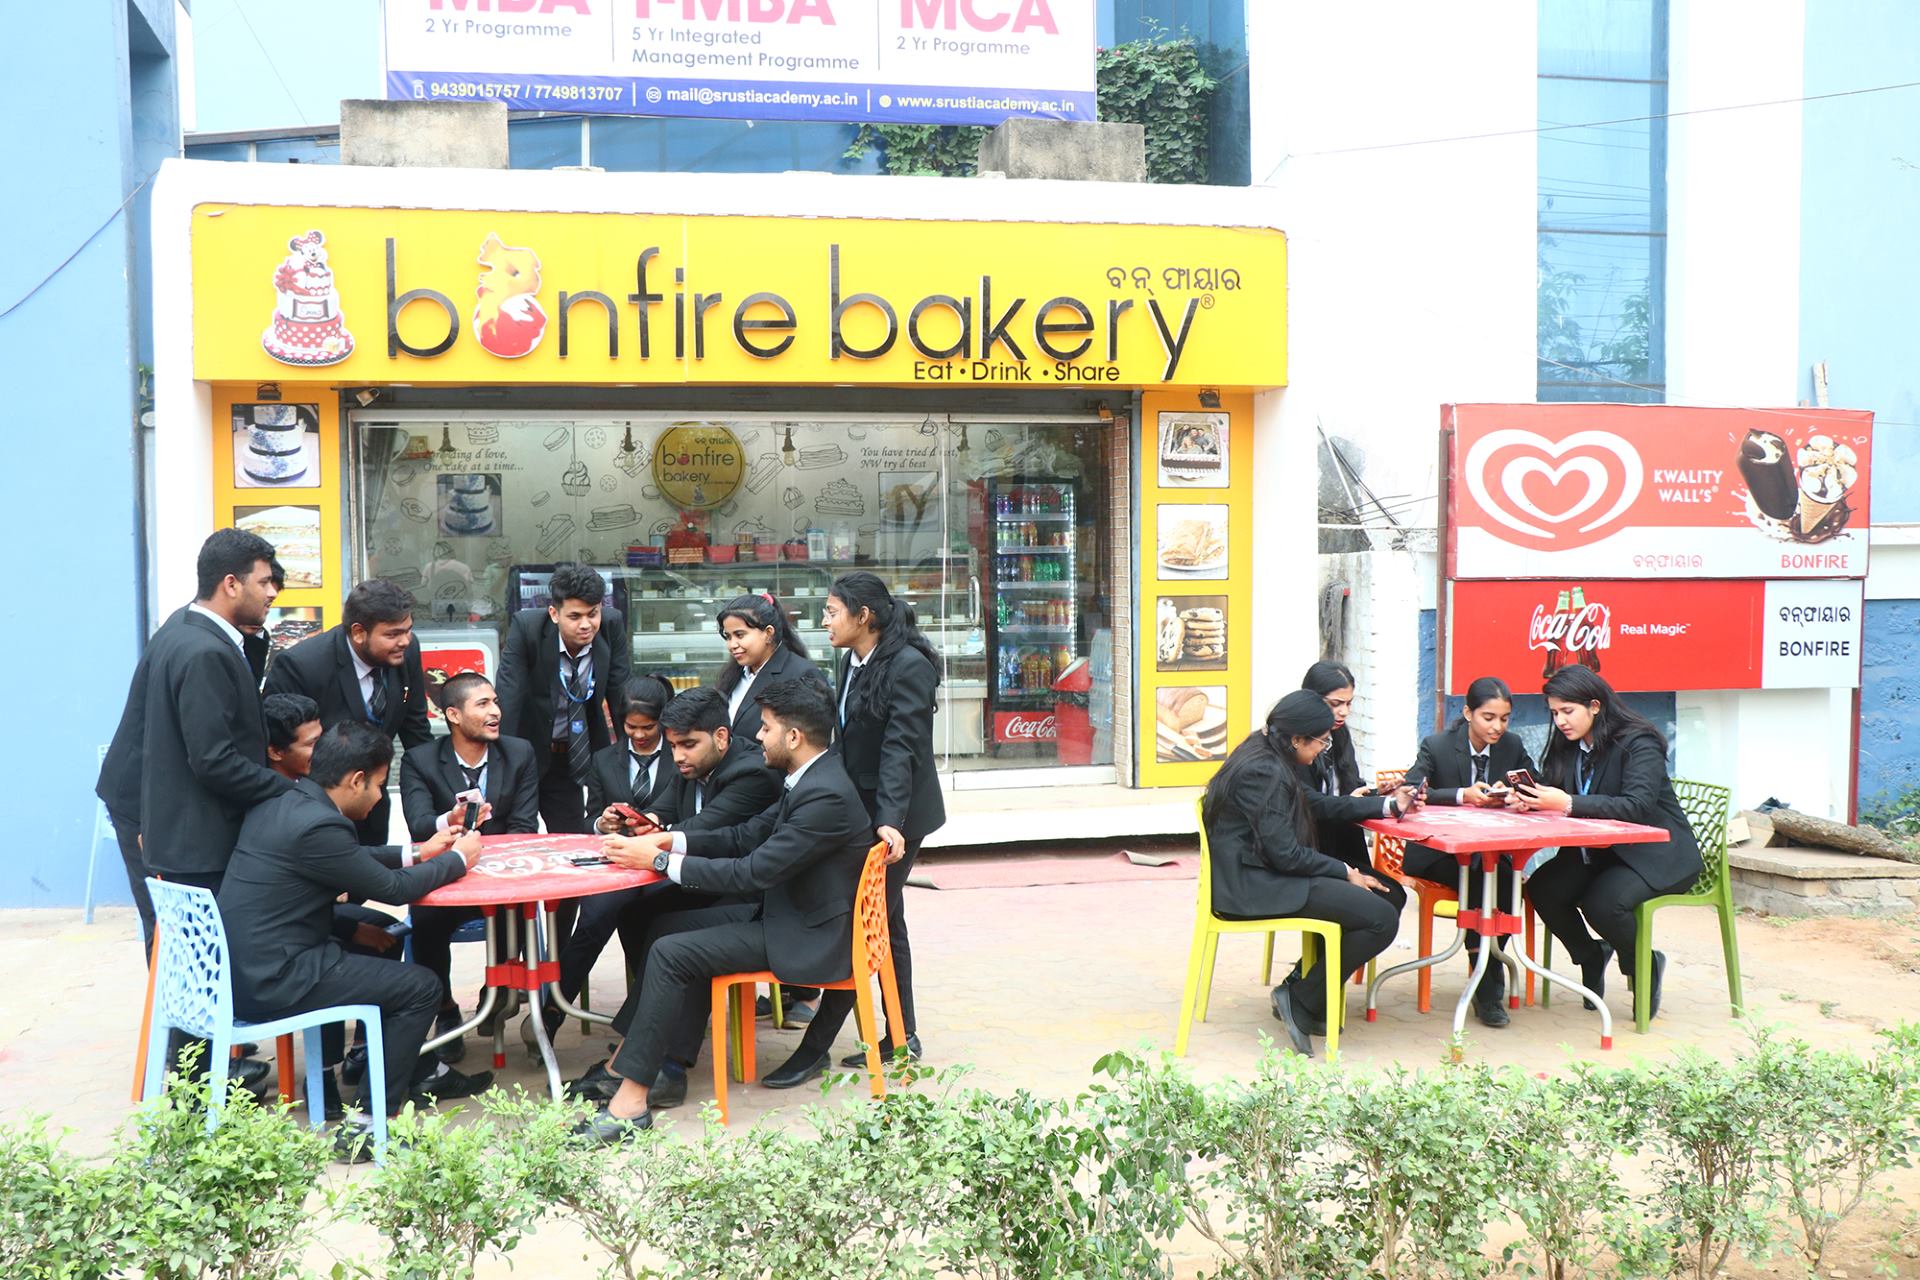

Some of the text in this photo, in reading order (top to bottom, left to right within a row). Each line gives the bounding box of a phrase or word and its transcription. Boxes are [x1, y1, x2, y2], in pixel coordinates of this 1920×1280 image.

[425, 18, 573, 38] 2 Yr Programme
[632, 27, 761, 47] 5 Yr Integrated
[896, 36, 1031, 56] 2 Yr Programme
[632, 49, 860, 71] Management Programme
[430, 82, 521, 98] 9439015757
[534, 85, 624, 101] 7749813707
[666, 87, 859, 108] mail@srustiacademy.ac.in
[896, 95, 1076, 114] www.srustiacademy.ac.in
[829, 243, 1200, 382] bakery
[914, 361, 1120, 381] Eat Drink Share
[861, 447, 879, 457] You
[881, 446, 903, 457] have
[906, 446, 928, 457] tried
[471, 463, 481, 471] at
[884, 460, 898, 470] try
[908, 459, 927, 468] best
[663, 468, 711, 484] bakery
[1653, 469, 1723, 484] KWALITY
[1780, 554, 1849, 569] BONFIRE
[1620, 624, 1648, 635] Real
[1779, 641, 1850, 656] BONFIRE
